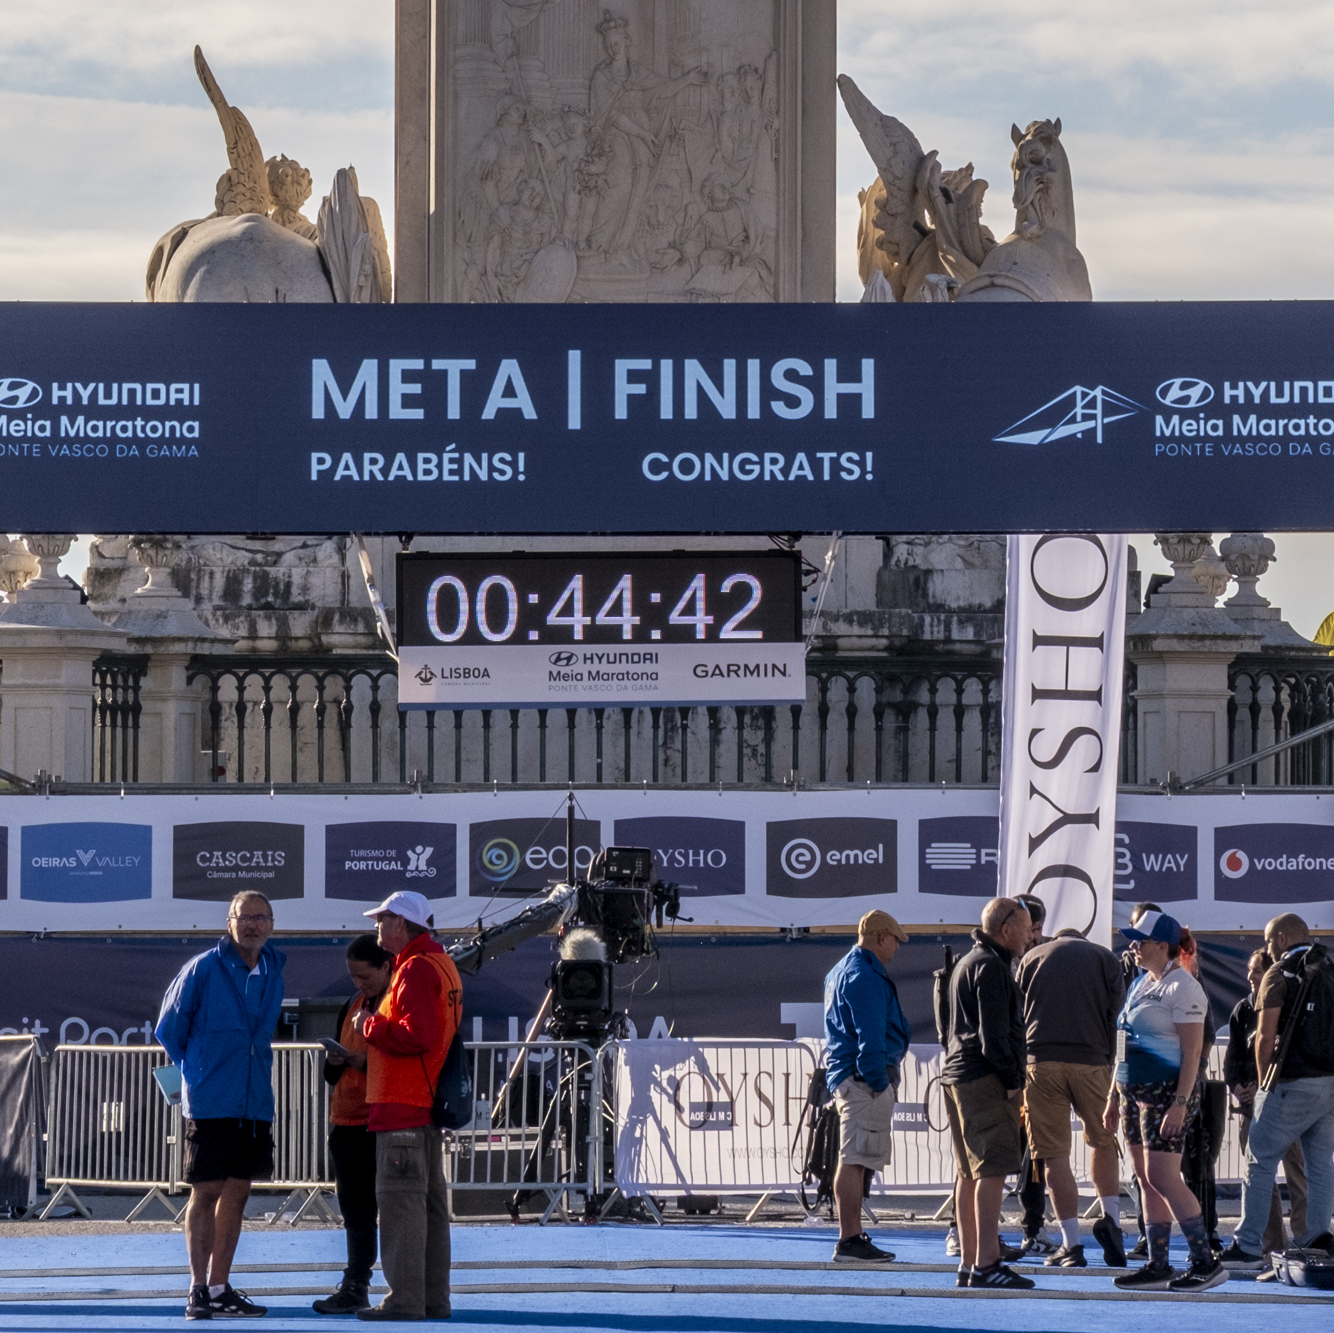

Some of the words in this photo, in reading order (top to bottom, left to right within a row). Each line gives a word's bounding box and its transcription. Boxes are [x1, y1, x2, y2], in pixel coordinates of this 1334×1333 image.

[52, 382, 200, 406] HYUNDAI
[311, 358, 538, 419] META
[614, 357, 876, 419] FINISH
[60, 415, 200, 438] Maratona
[1155, 414, 1224, 437] Meia
[47, 443, 109, 457] VASCO
[115, 443, 139, 457] DA
[146, 443, 199, 457] GAMA
[1155, 443, 1214, 456] PONTE
[1220, 443, 1282, 456] VASCO
[1289, 443, 1312, 456] DA
[310, 443, 526, 481] PARABÉNS!
[641, 451, 874, 481] CONGRATS!
[426, 573, 764, 642] 00:44:42
[583, 653, 659, 665] HYUNDAI
[441, 667, 491, 679] LISBOA
[548, 670, 584, 682] Meia
[588, 669, 659, 682] Maratona
[692, 663, 788, 678] GARMIN
[1027, 533, 1109, 937] OYSHO
[31, 857, 77, 867] OEIRAS
[95, 856, 141, 867] VALLEY
[196, 851, 285, 867] CASCAIS
[654, 849, 727, 868] YSHO
[826, 843, 883, 865] emel
[345, 861, 403, 871] PORTUGAL
[1143, 854, 1188, 872] WAY
[206, 870, 236, 878] Câmara
[238, 870, 275, 880] Municipal
[674, 1071, 814, 1129] OYSH
[727, 1147, 807, 1159] WWW.OYSHO.CO
